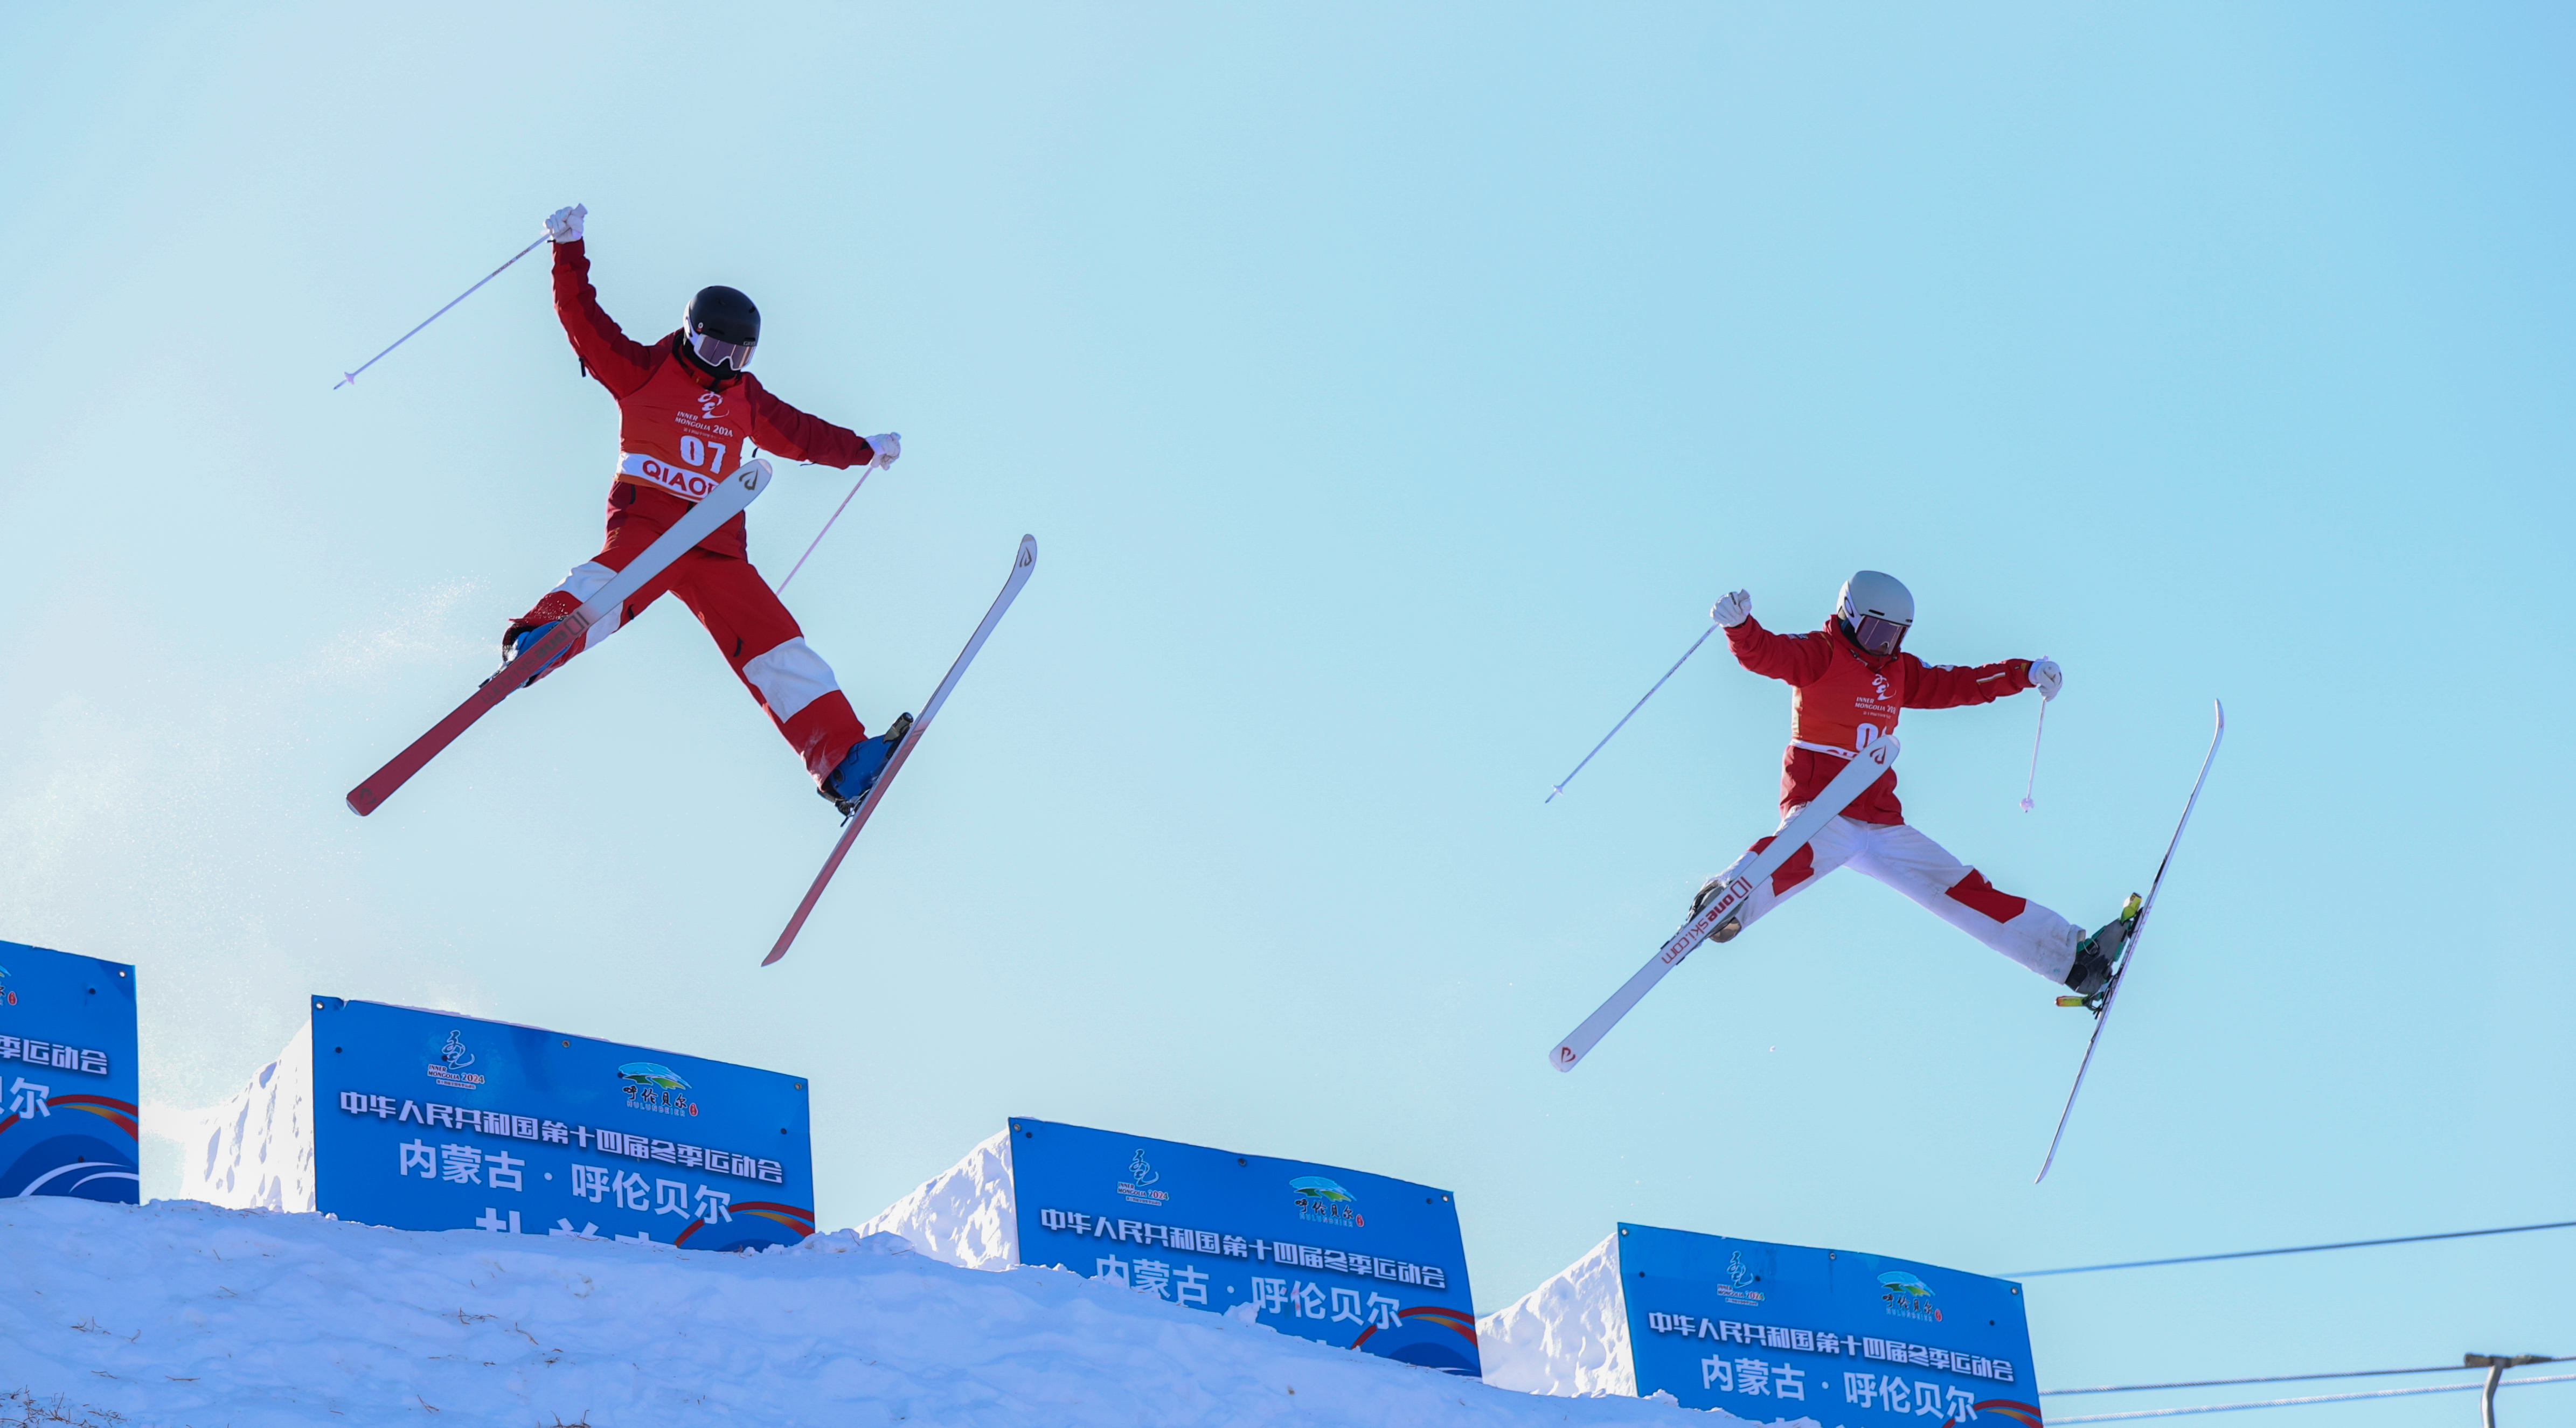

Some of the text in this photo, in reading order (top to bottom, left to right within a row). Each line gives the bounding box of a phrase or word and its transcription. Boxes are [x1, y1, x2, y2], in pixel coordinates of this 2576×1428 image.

[675, 416, 711, 431] MONGOLIA
[712, 424, 733, 437] 2024
[677, 411, 698, 421] INNER
[680, 435, 726, 474] 07
[642, 460, 719, 497] QIAO
[1855, 702, 1885, 712] MONGOLIA
[1856, 723, 1888, 752] 0
[428, 1070, 485, 1084] MONGOLIA 2024
[623, 1085, 688, 1109] 呼伦贝尔
[627, 1100, 685, 1117] HULUNBEIER
[341, 1091, 783, 1184] 中华人民共和国第十四届冬季运动会
[1118, 1188, 1169, 1200] MONGOLIA 2024
[1295, 1198, 1354, 1220] 呼伦贝尔
[1040, 1208, 1446, 1289] 中华人民共和国第十四届冬季运动会
[1648, 1311, 2015, 1382] 中华人民共和国第十四届冬季运动会
